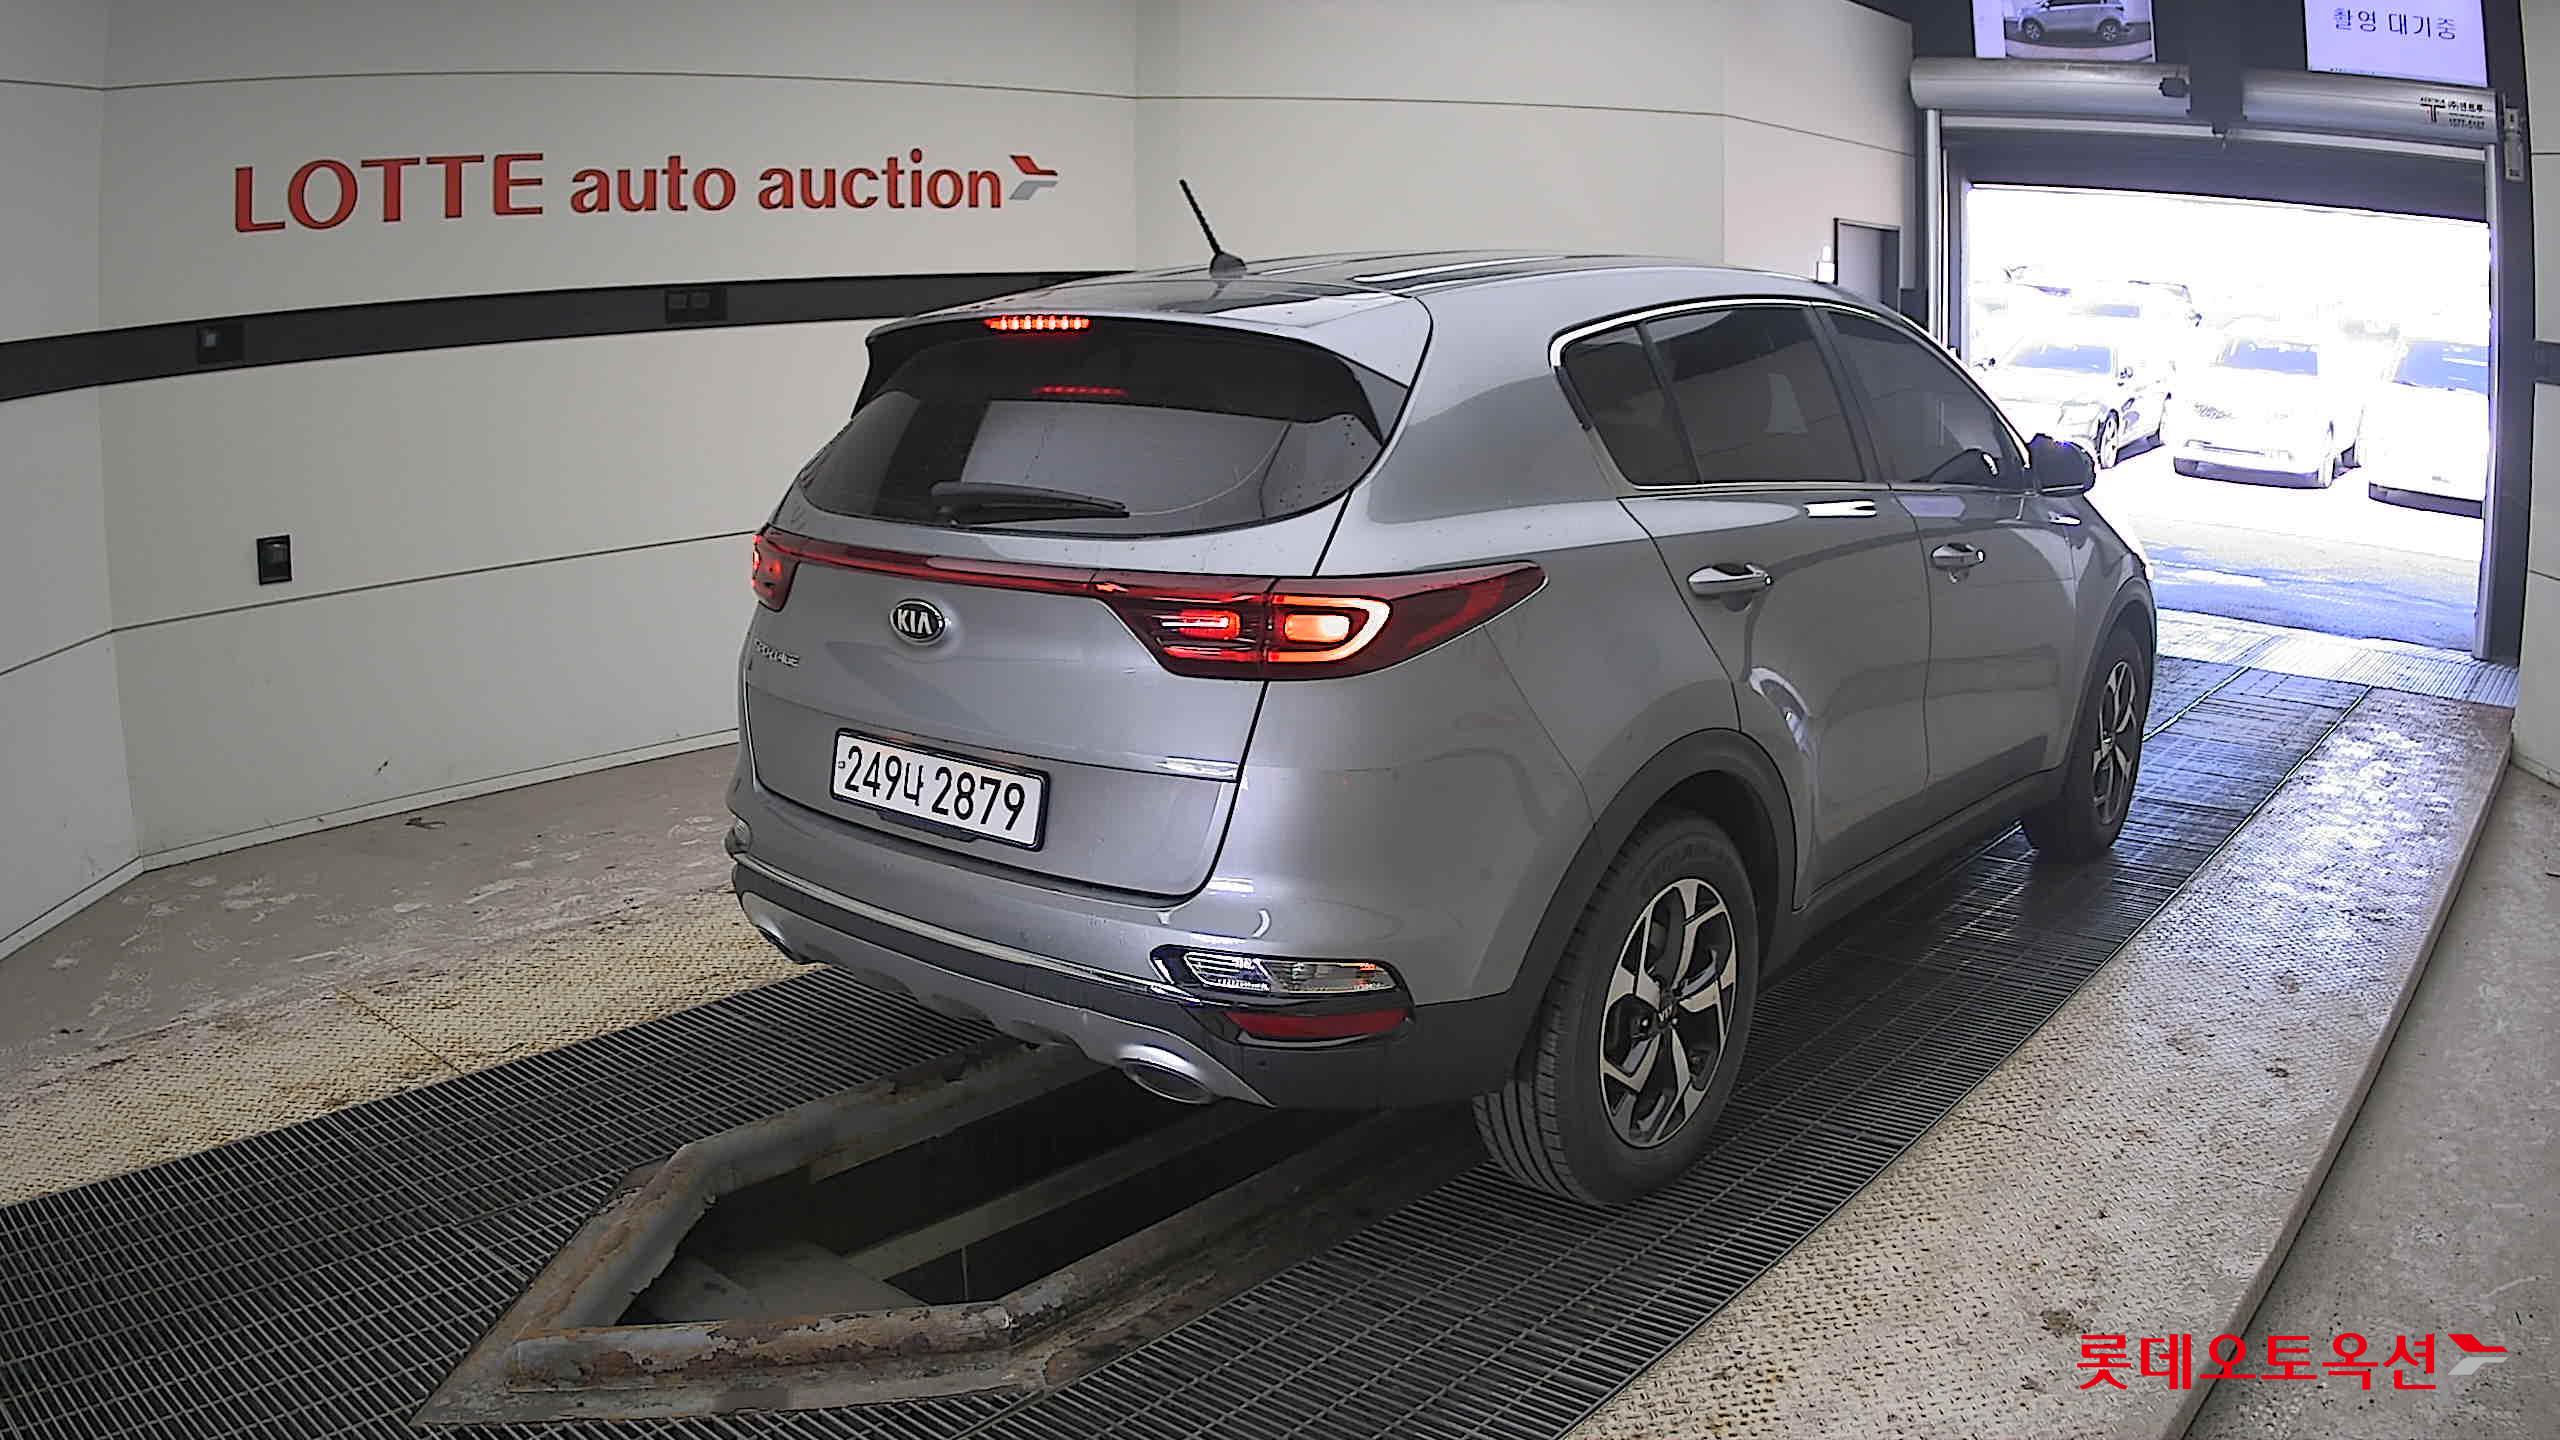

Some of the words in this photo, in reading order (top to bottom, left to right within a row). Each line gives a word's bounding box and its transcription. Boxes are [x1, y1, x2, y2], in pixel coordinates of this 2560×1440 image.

[2388, 13, 2457, 40] 대기중
[234, 153, 544, 233] LOTTE
[569, 154, 737, 214] auto
[757, 148, 1003, 211] auction
[897, 608, 933, 635] KIA
[844, 744, 925, 807] 249나
[930, 766, 1026, 831] 2879
